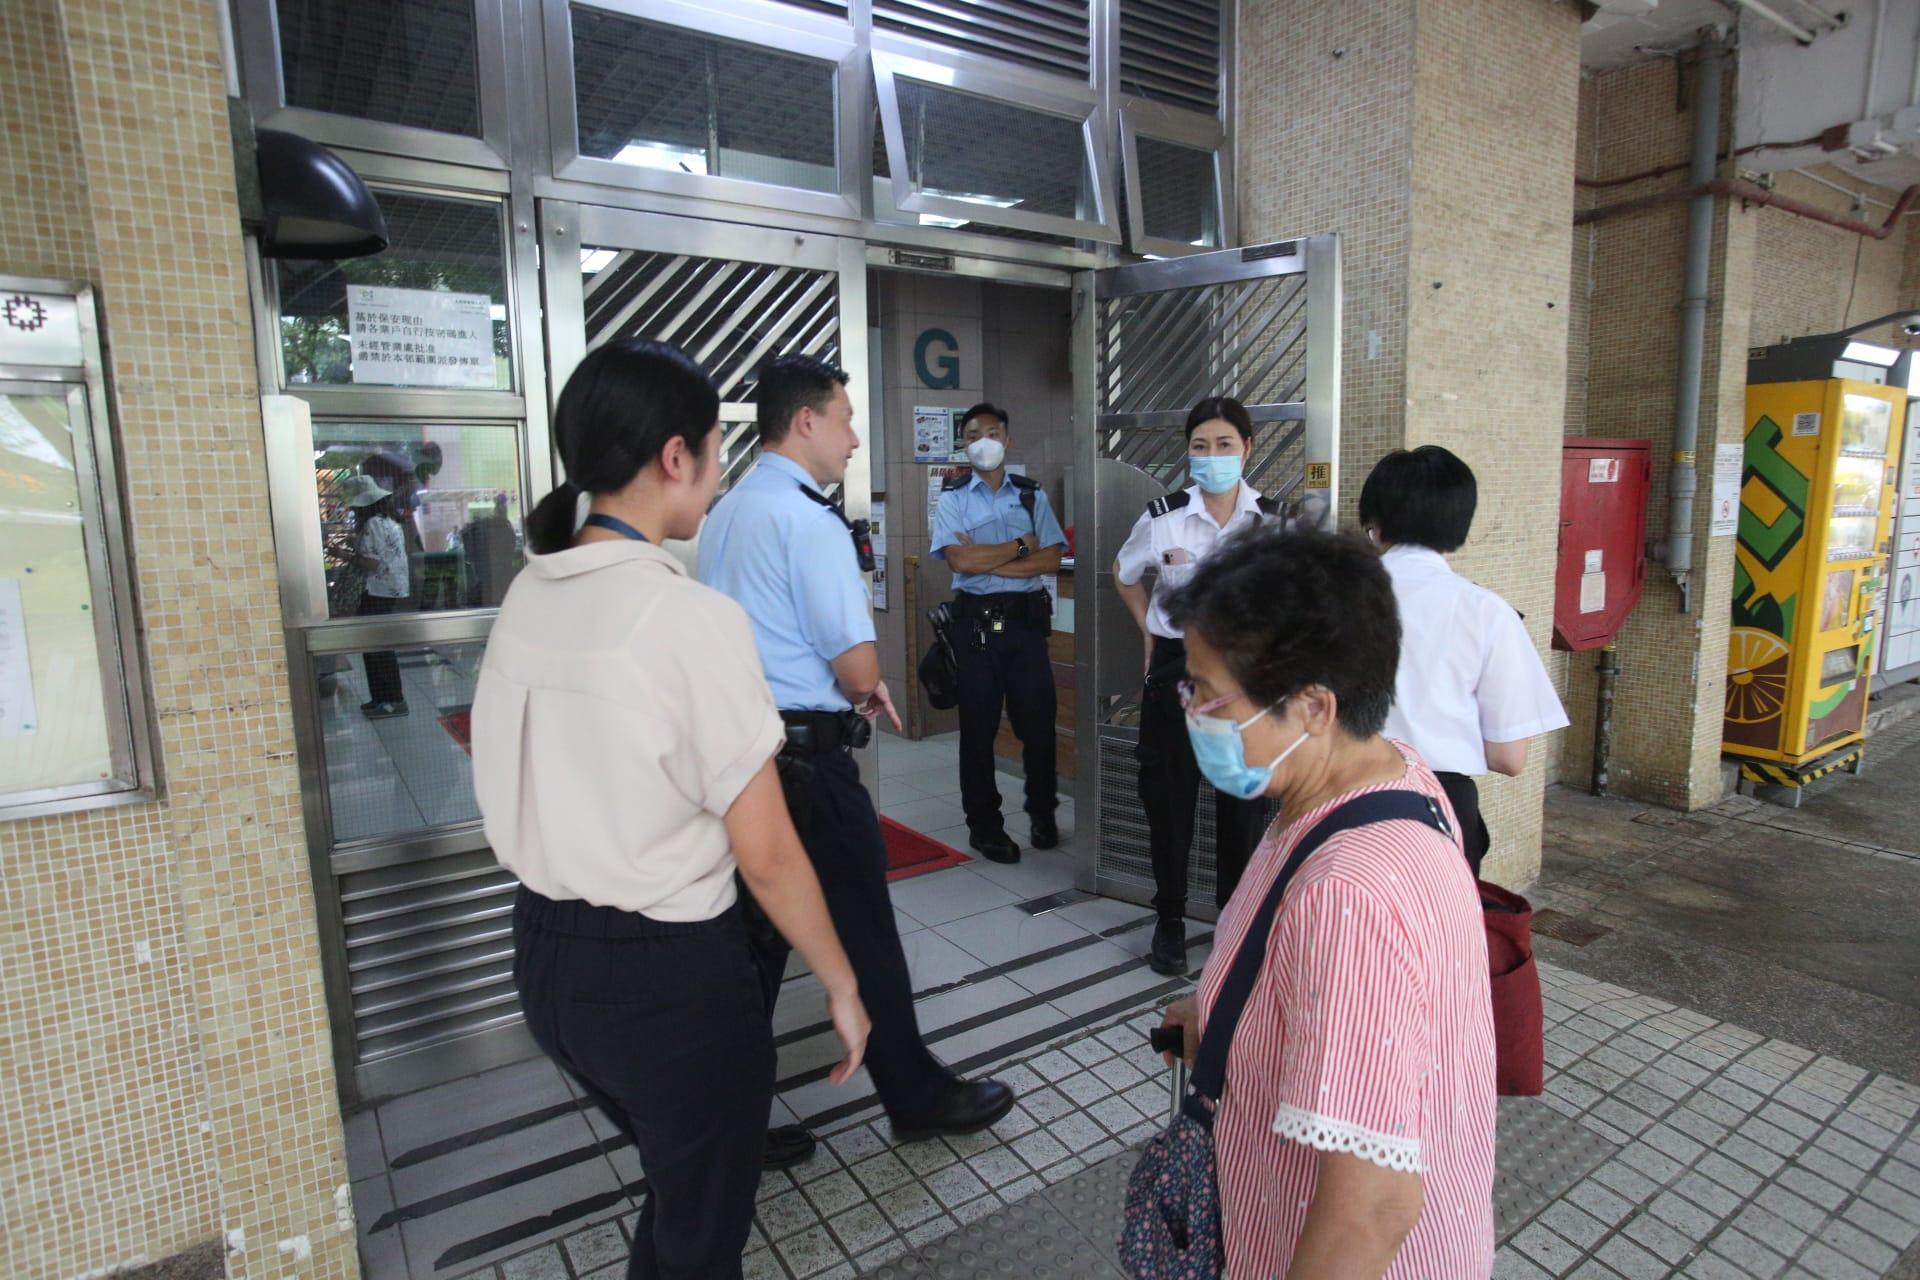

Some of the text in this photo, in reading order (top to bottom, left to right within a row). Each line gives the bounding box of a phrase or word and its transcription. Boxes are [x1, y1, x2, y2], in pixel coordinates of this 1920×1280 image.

[355, 311, 423, 326] 基於保安理由
[913, 328, 960, 390] G
[1311, 465, 1326, 480] 推
